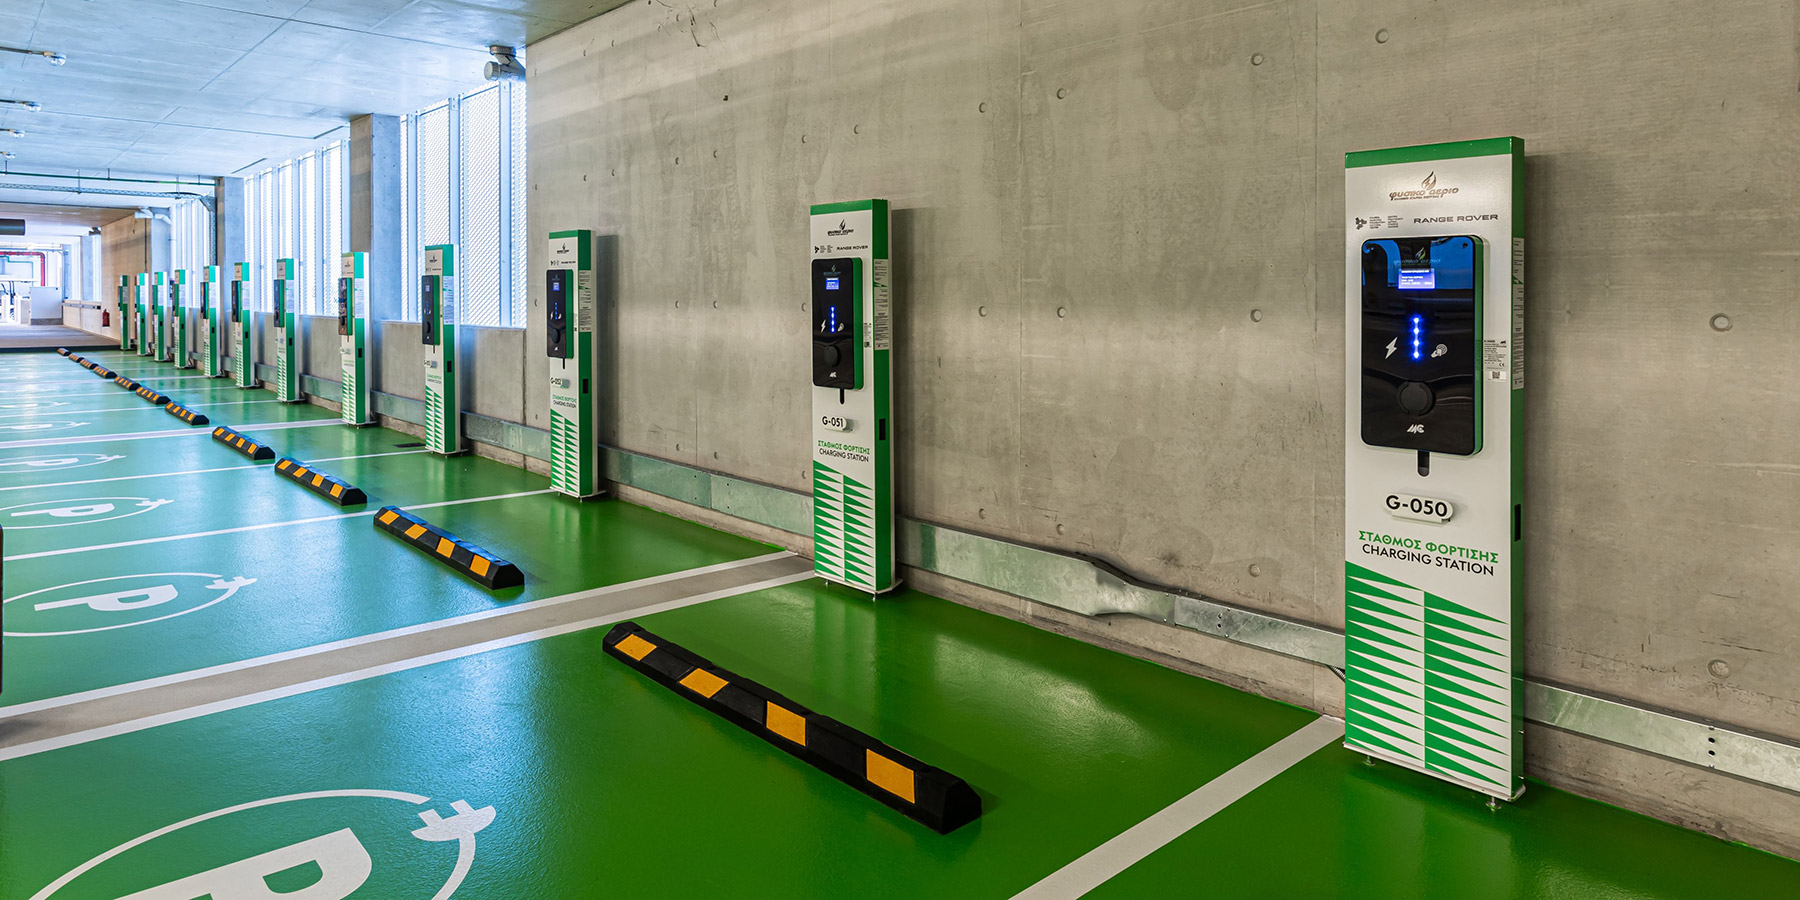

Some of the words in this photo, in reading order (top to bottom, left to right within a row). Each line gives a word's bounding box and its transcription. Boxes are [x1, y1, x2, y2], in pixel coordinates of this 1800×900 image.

[1413, 216, 1454, 224] RANGE
[1457, 214, 1498, 222] ROVER
[822, 416, 844, 427] G-051
[818, 440, 842, 450] ΣΤΑΘΜΟΣ
[843, 445, 870, 454] ΦΟΡΤΙΣΗΣ
[819, 448, 846, 459] CHARGING
[846, 453, 869, 462] STATION
[1385, 495, 1448, 517] G-050
[1358, 530, 1422, 550] ΣΤΑΘΜΟΣ
[1425, 541, 1499, 564] ΦΟΡΤΙΣΗΣ
[1362, 544, 1432, 565] CHARGING
[1435, 556, 1494, 577] STATION
[34, 584, 179, 611] P
